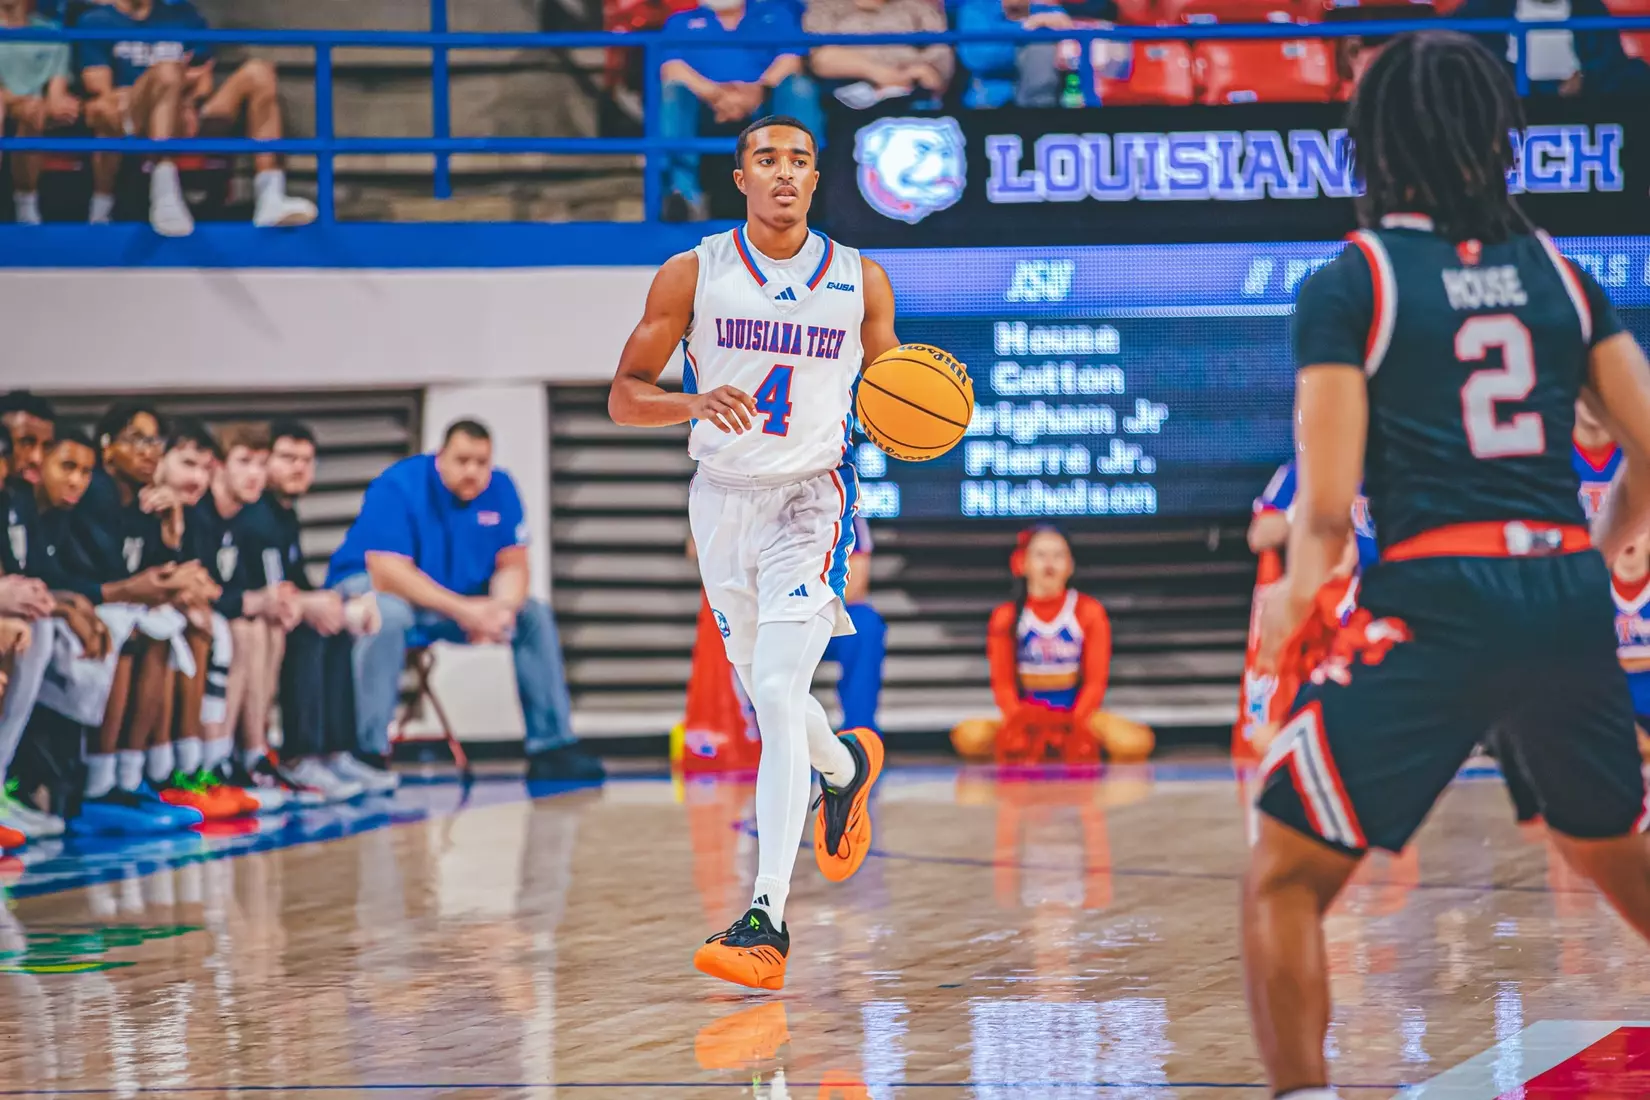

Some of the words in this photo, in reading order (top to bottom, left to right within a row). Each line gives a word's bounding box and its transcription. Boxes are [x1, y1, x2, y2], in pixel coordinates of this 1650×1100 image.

[985, 128, 1367, 203] LOUISIAN
[715, 318, 802, 355] LOUISIANA
[806, 325, 847, 360] TECH
[752, 363, 795, 438] 4
[1454, 312, 1546, 459] 2
[1122, 398, 1169, 434] Jr
[1096, 438, 1157, 474] Jr.
[960, 479, 1157, 517] Nicholson
